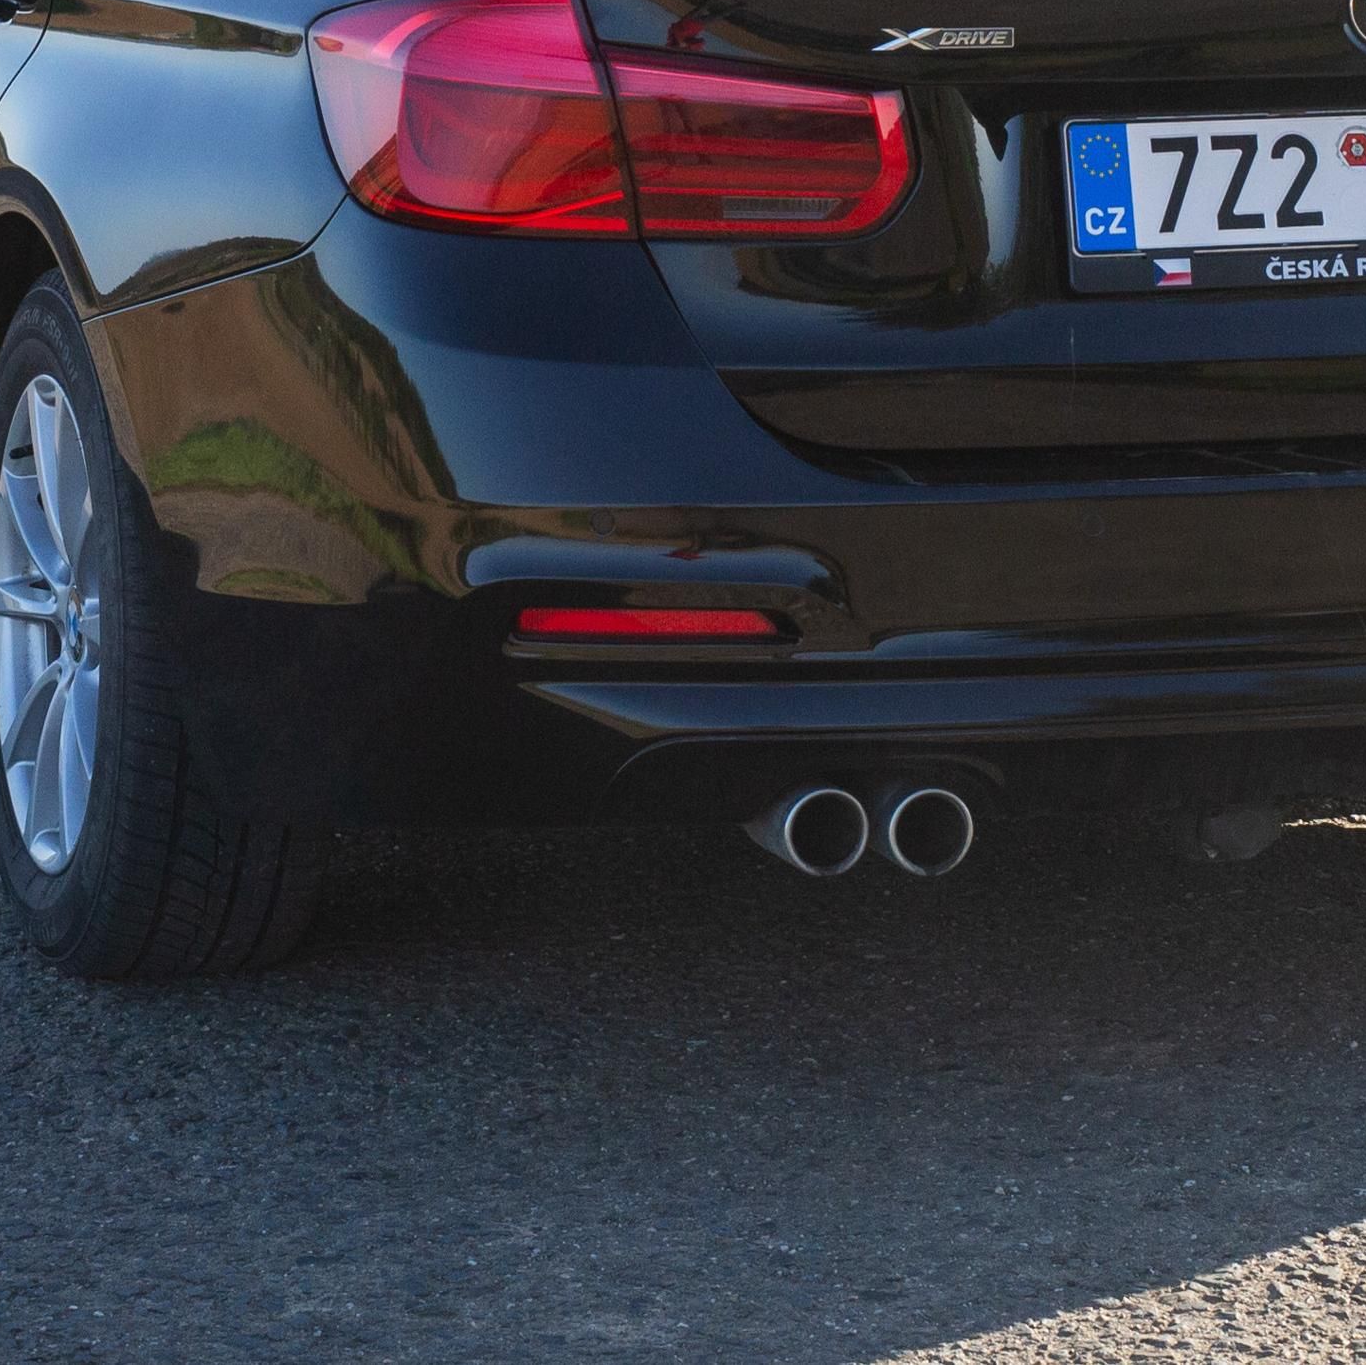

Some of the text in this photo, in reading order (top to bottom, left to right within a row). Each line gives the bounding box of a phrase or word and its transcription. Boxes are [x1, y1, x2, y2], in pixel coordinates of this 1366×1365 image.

[1150, 133, 1324, 233] 7Z2
[1085, 207, 1127, 235] CZ
[1265, 254, 1349, 281] ČESKÁ
